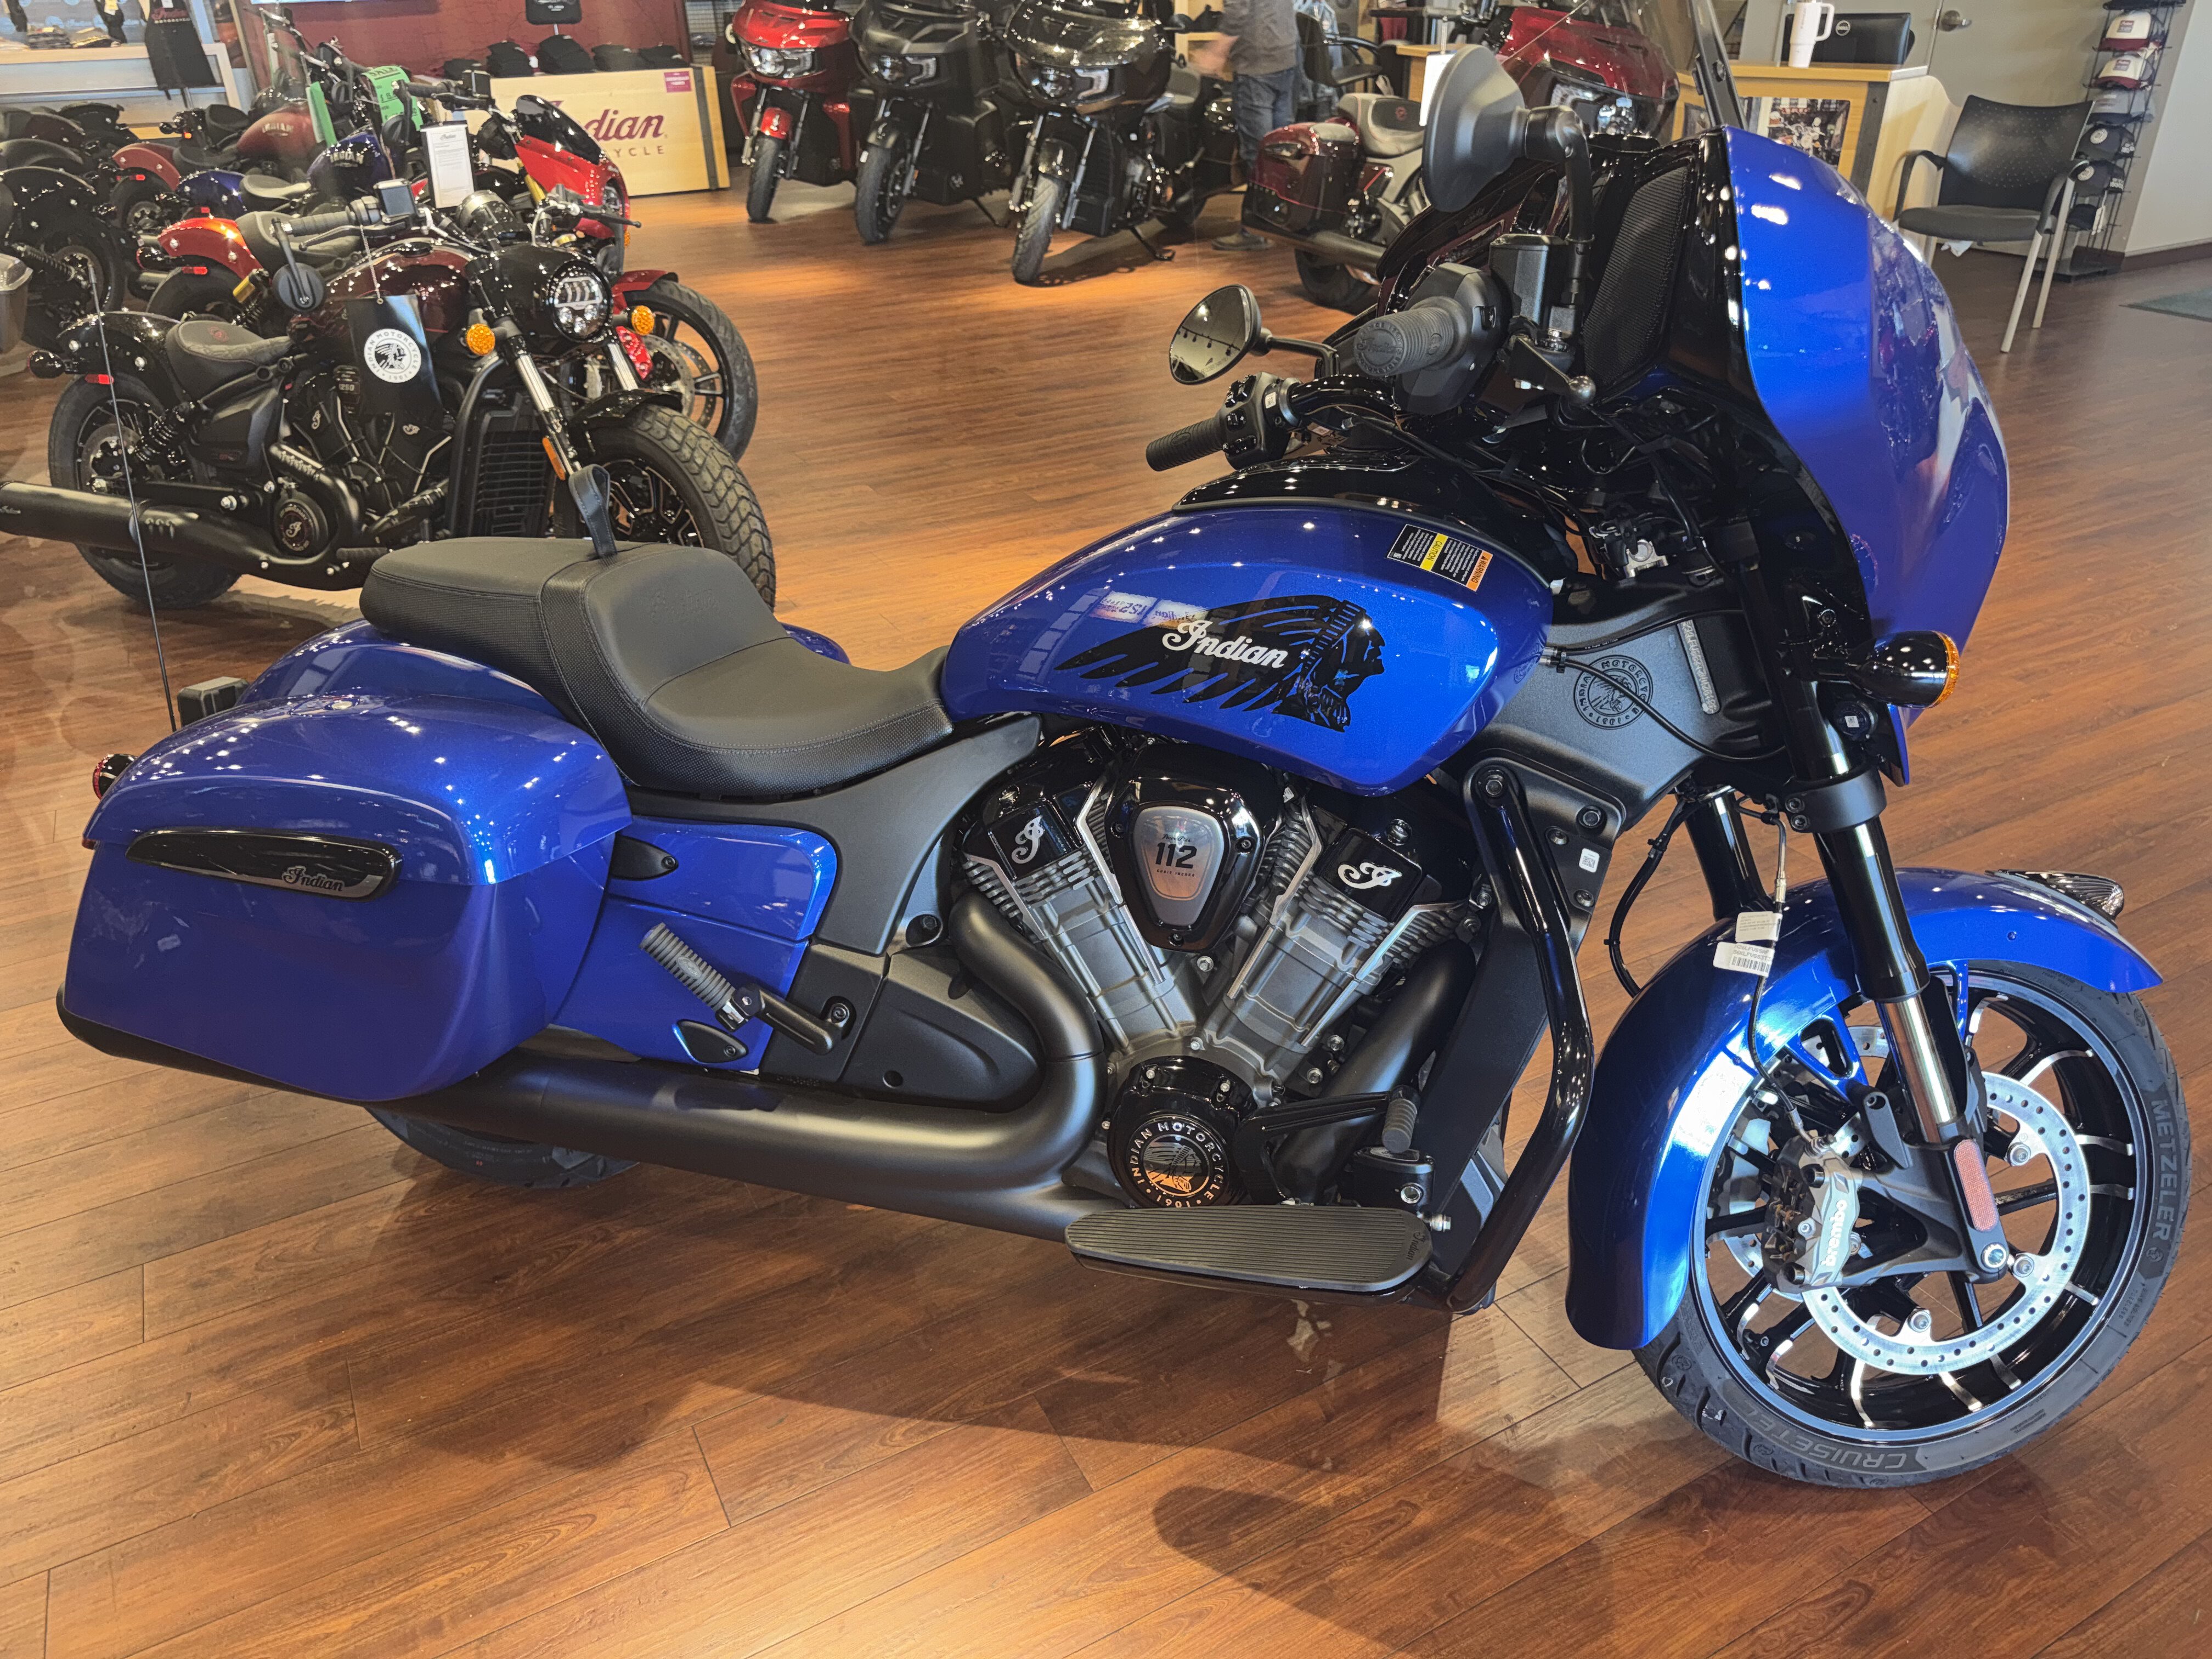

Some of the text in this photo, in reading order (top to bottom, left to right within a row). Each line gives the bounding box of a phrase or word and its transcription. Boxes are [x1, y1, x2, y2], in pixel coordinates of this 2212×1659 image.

[367, 331, 419, 373] INDIAN MOTORCYCLE
[1426, 540, 1442, 561] CAUTION
[1471, 558, 1489, 584] WARNING
[1162, 619, 1288, 668] Indian
[1579, 676, 1592, 712] INDIA
[1601, 660, 1648, 718] MOTORCYCE
[1155, 842, 1198, 870] 112
[283, 866, 343, 891] Indian
[1130, 1121, 1224, 1200] INDIAN MOTORCYCLE
[2150, 1099, 2177, 1241] METZELER
[1156, 1194, 1191, 1208] 1901
[1406, 1232, 1426, 1261] Indian
[1820, 1199, 1848, 1266] brembo
[1735, 1401, 1908, 1469] CRUISETEC
